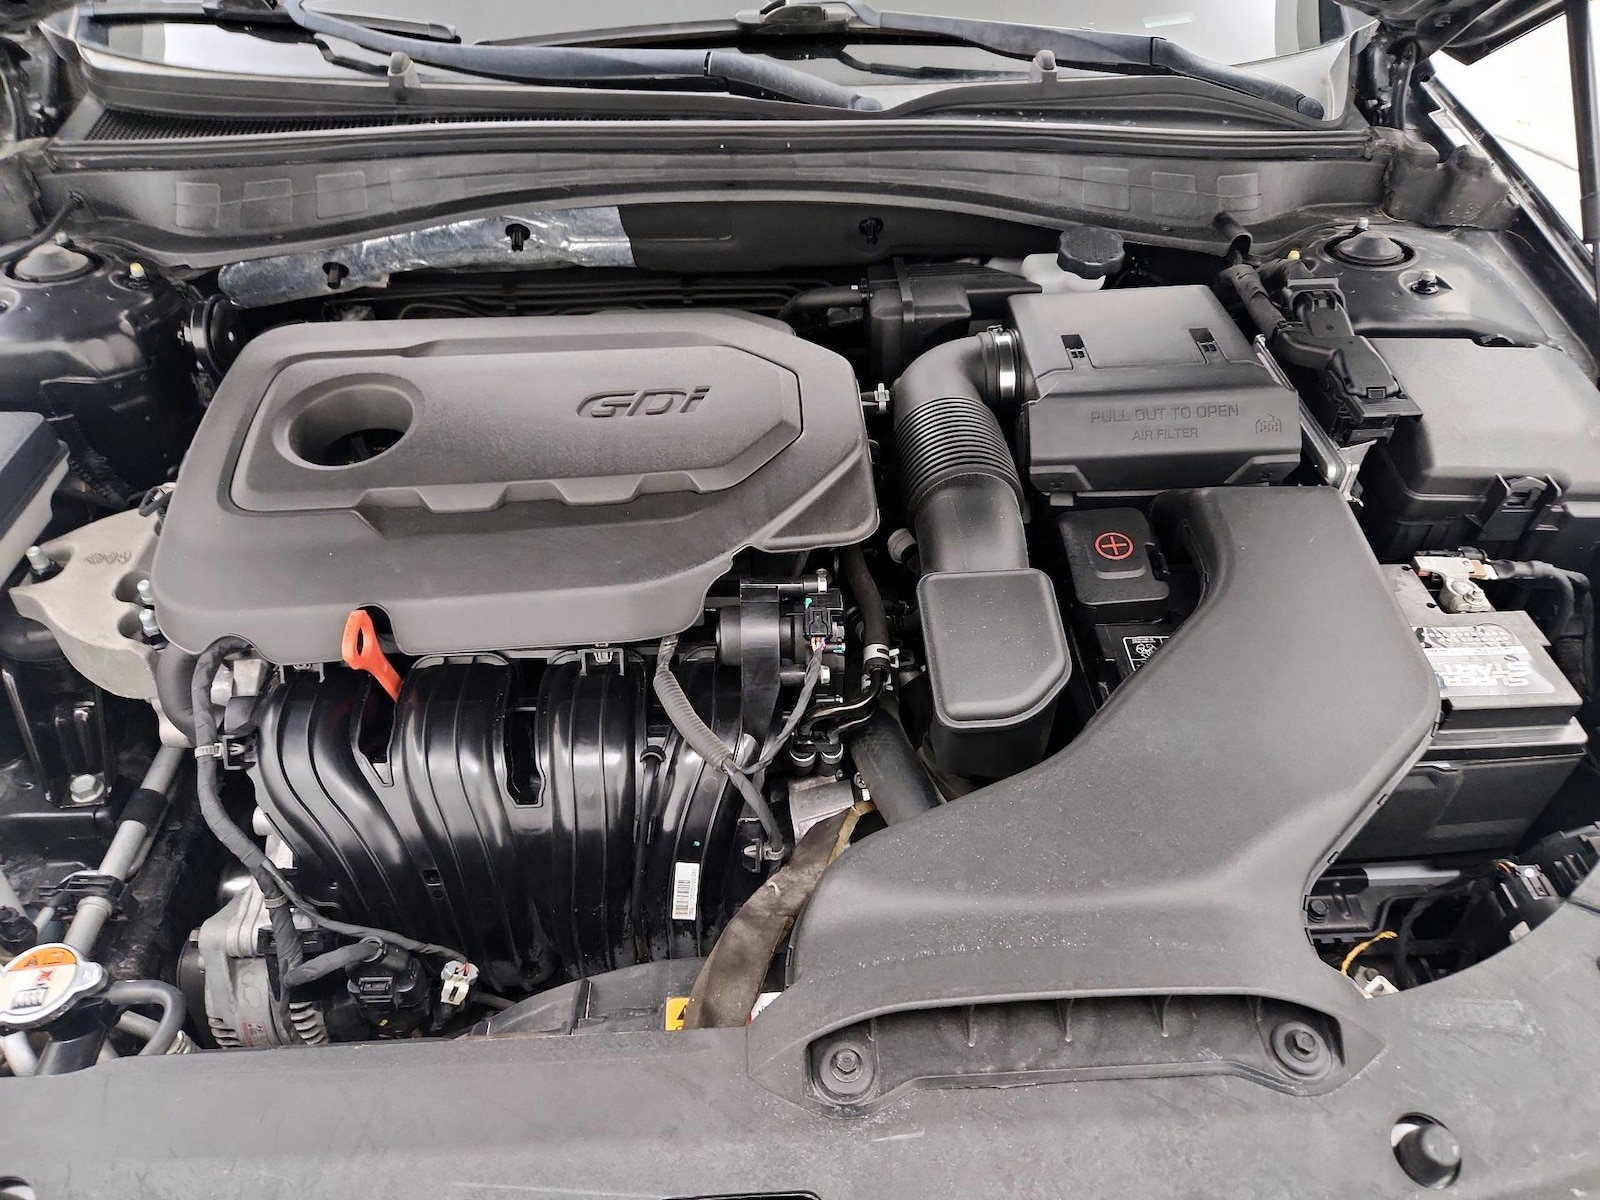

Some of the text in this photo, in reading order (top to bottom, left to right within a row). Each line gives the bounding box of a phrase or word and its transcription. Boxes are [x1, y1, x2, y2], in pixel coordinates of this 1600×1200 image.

[576, 385, 712, 418] GDi
[1090, 403, 1239, 423] PULL OUT TO OPEN
[1131, 427, 1199, 441] AIR FILTER
[1444, 661, 1533, 676] START
[1444, 674, 1529, 687] SUPER
